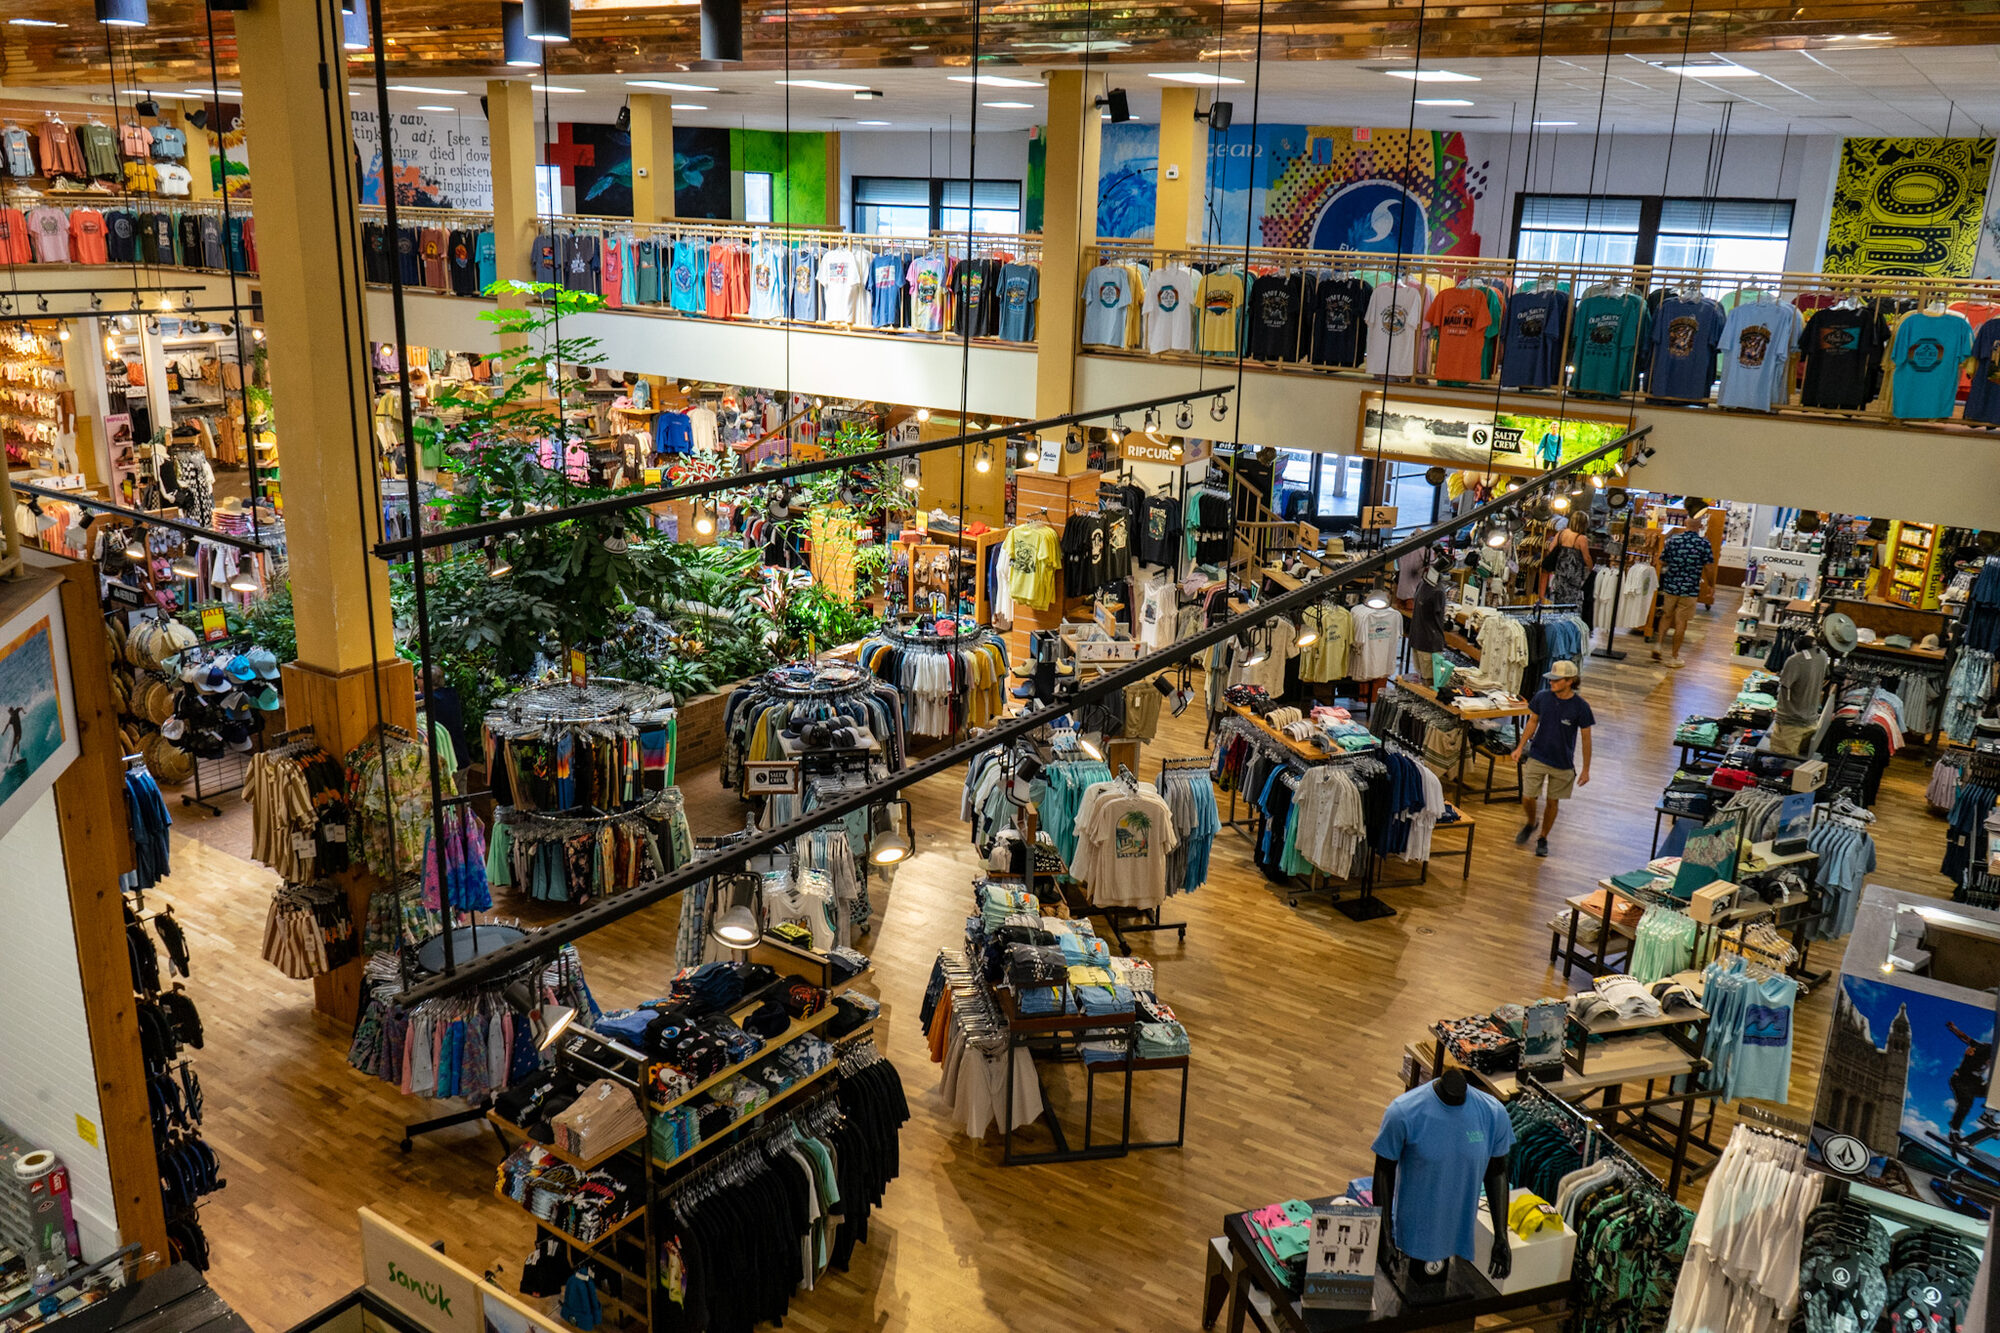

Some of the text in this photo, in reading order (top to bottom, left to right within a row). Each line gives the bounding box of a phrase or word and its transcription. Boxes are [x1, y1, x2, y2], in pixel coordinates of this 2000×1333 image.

[412, 130, 436, 146] adj.
[1357, 128, 1369, 140] EXIT
[430, 146, 455, 161] died
[466, 147, 491, 162] dow
[434, 164, 446, 177] in
[450, 164, 492, 178] existen
[1494, 430, 1520, 442] SALTY
[1493, 440, 1517, 450] CREW
[203, 607, 223, 617] SALE
[388, 1261, 454, 1319] sanük
[1317, 1285, 1370, 1296] VOLCOM
